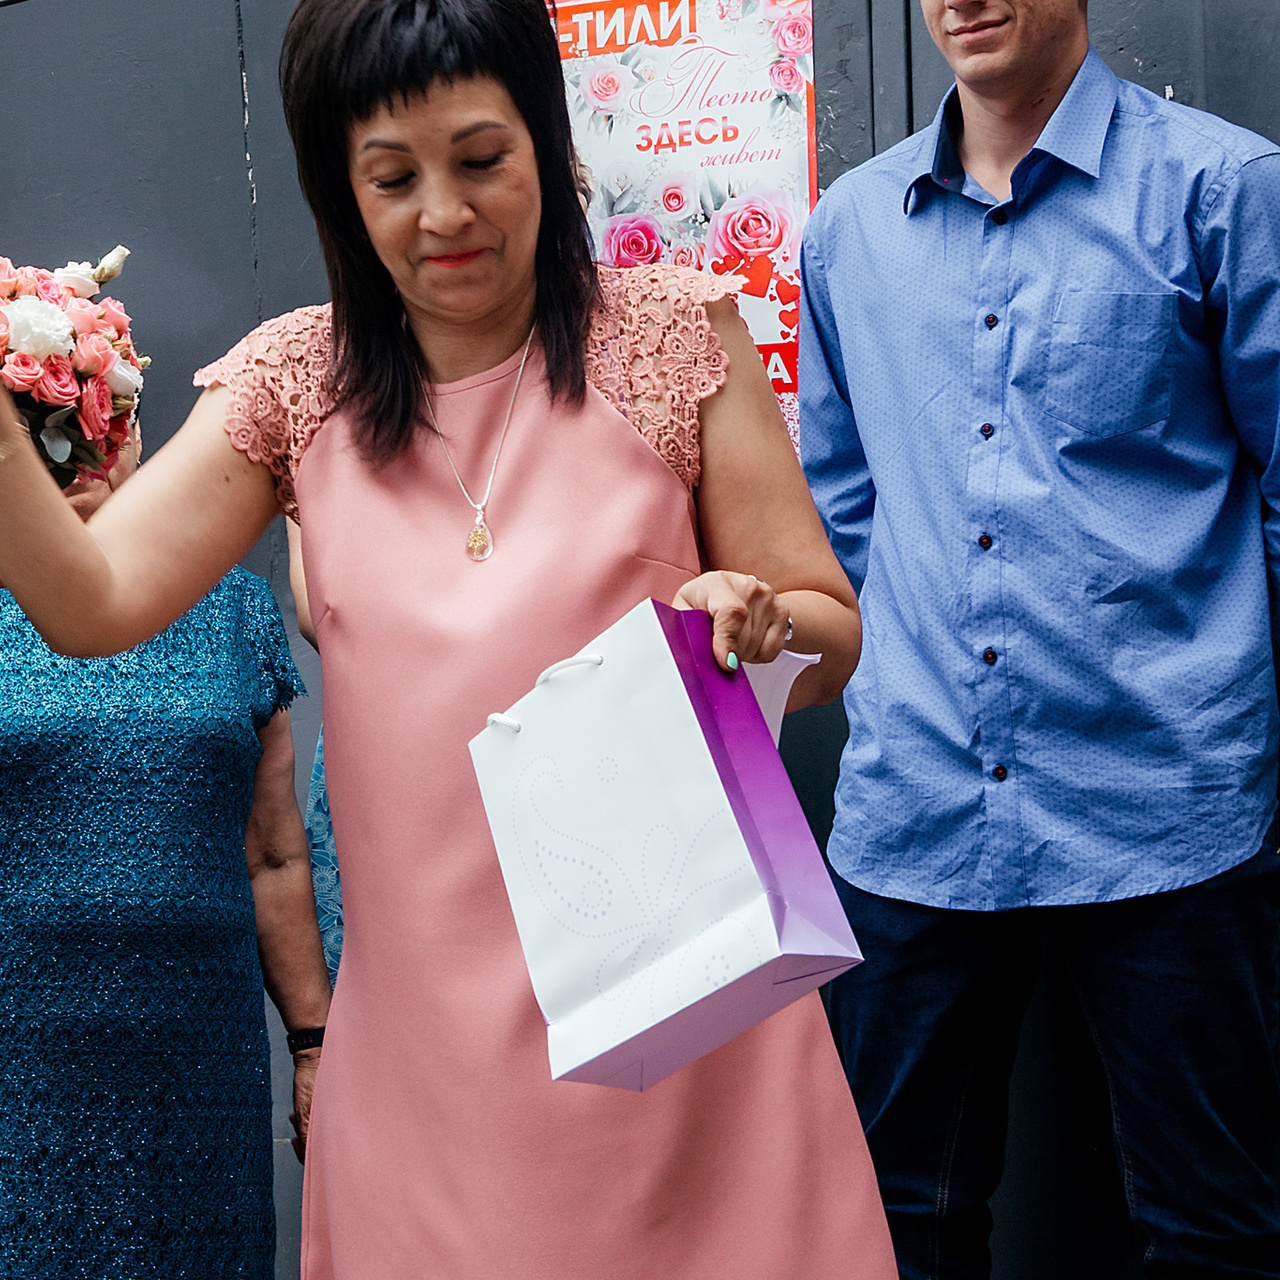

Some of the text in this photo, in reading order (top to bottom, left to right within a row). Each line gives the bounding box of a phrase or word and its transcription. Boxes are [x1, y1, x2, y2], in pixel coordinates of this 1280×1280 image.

[629, 34, 773, 118] Тесто
[635, 116, 740, 155] ЗДЕСЬ
[700, 126, 783, 168] живет
